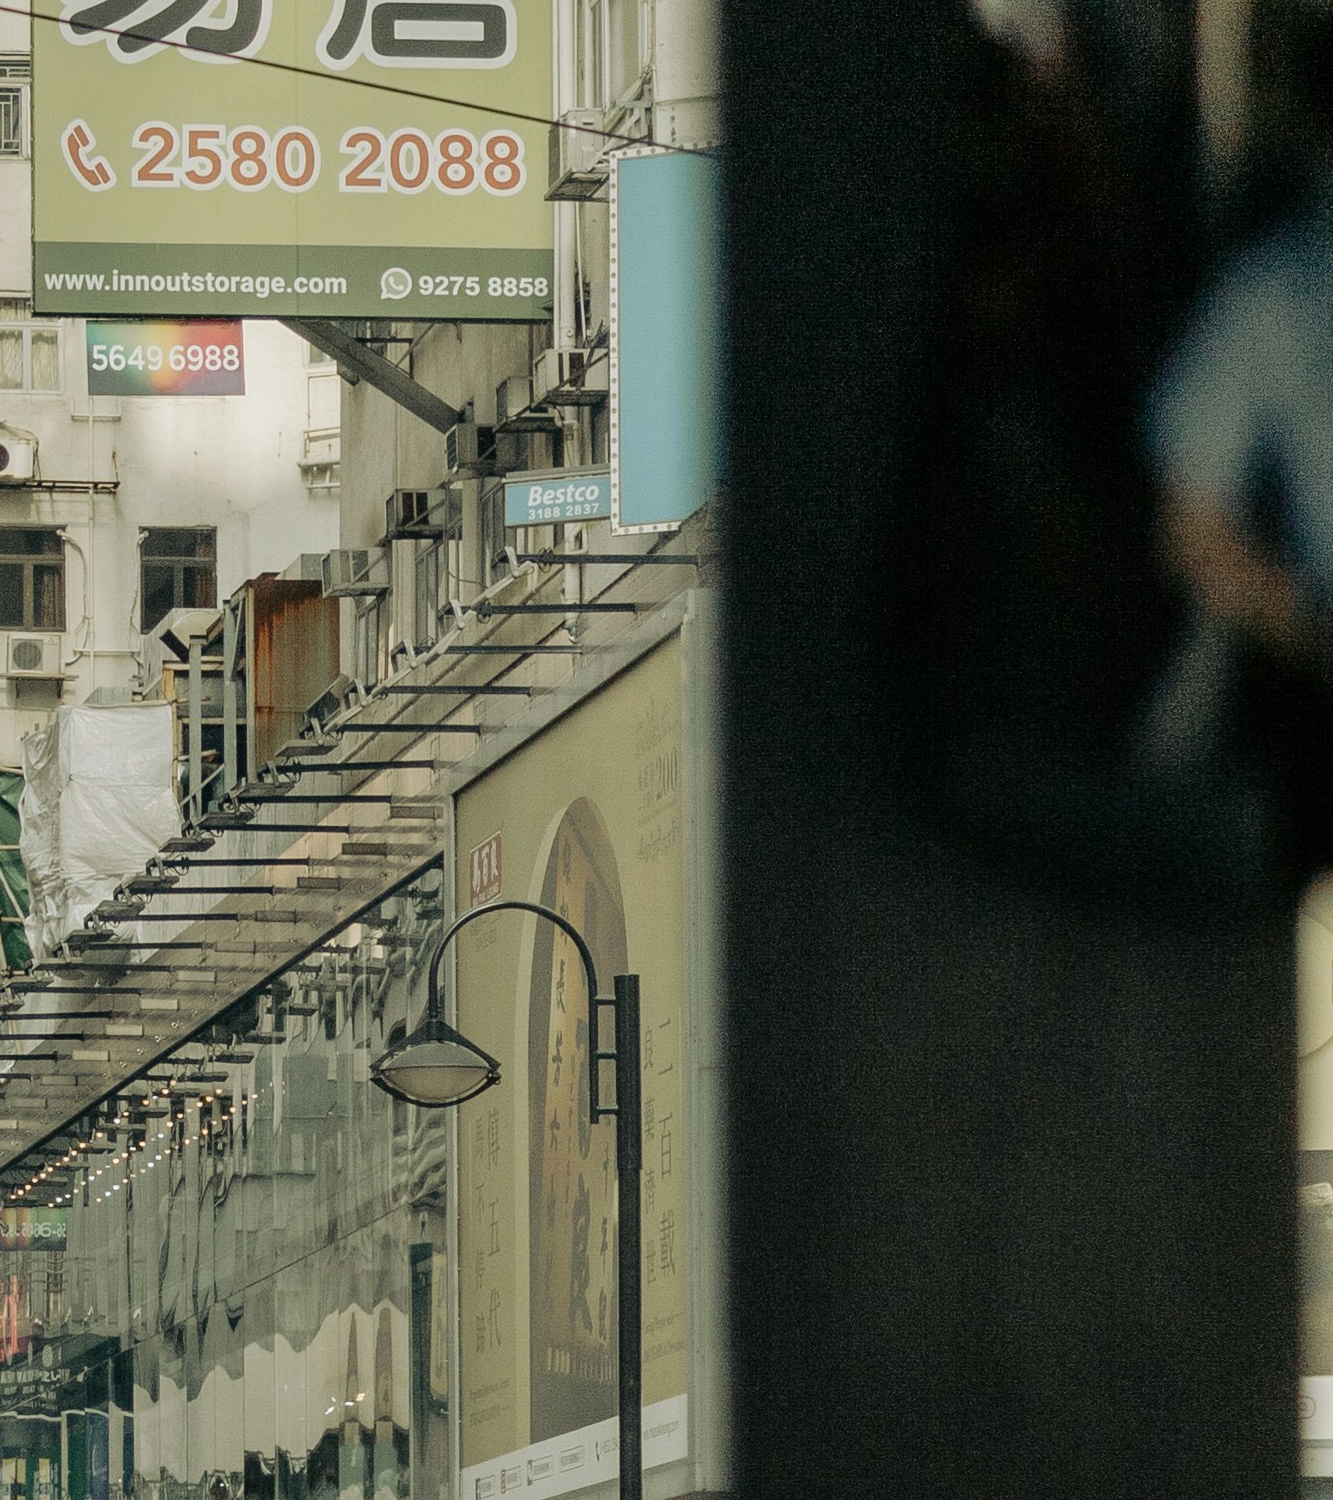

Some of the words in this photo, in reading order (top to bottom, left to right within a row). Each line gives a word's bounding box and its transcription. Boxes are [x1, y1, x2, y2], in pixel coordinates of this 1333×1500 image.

[134, 122, 319, 193] 2580
[338, 129, 526, 196] 2088
[44, 269, 347, 299] www.innoutstorage.com
[418, 275, 480, 297] 9275
[488, 276, 549, 298] 8858
[91, 344, 164, 371] 5649
[169, 344, 240, 371] 6988
[528, 484, 600, 507] Bestco
[528, 507, 561, 520] 3188
[566, 503, 600, 517] 2837
